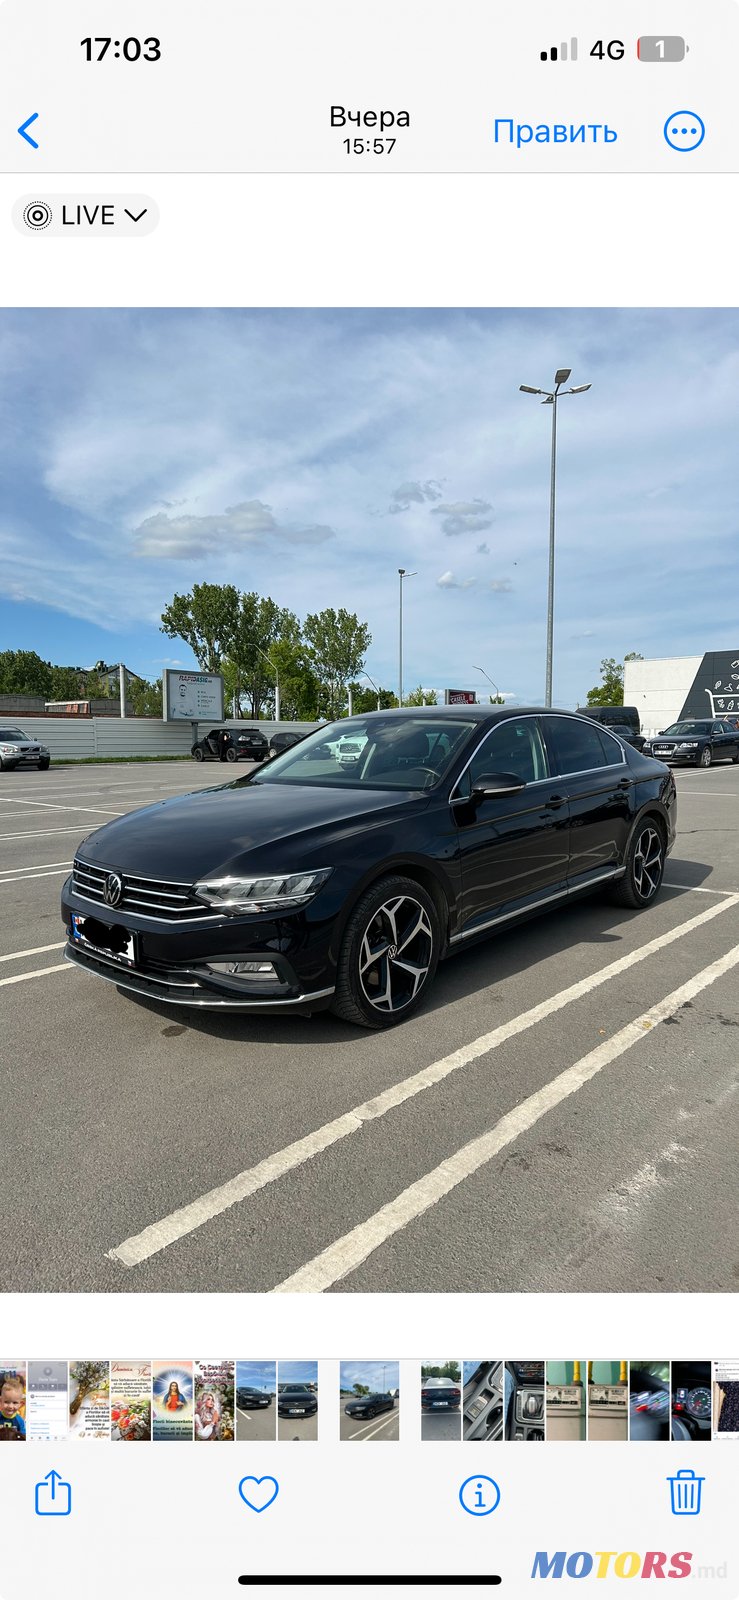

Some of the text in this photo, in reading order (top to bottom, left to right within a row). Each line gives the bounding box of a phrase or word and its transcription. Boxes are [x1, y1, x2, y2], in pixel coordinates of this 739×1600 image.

[80, 37, 162, 62] 17:03
[589, 40, 625, 61] 4G
[655, 40, 666, 59] 1
[329, 105, 411, 132] Вчера
[493, 118, 618, 148] Править
[342, 138, 397, 155] 15:57
[62, 205, 115, 226] LIVE
